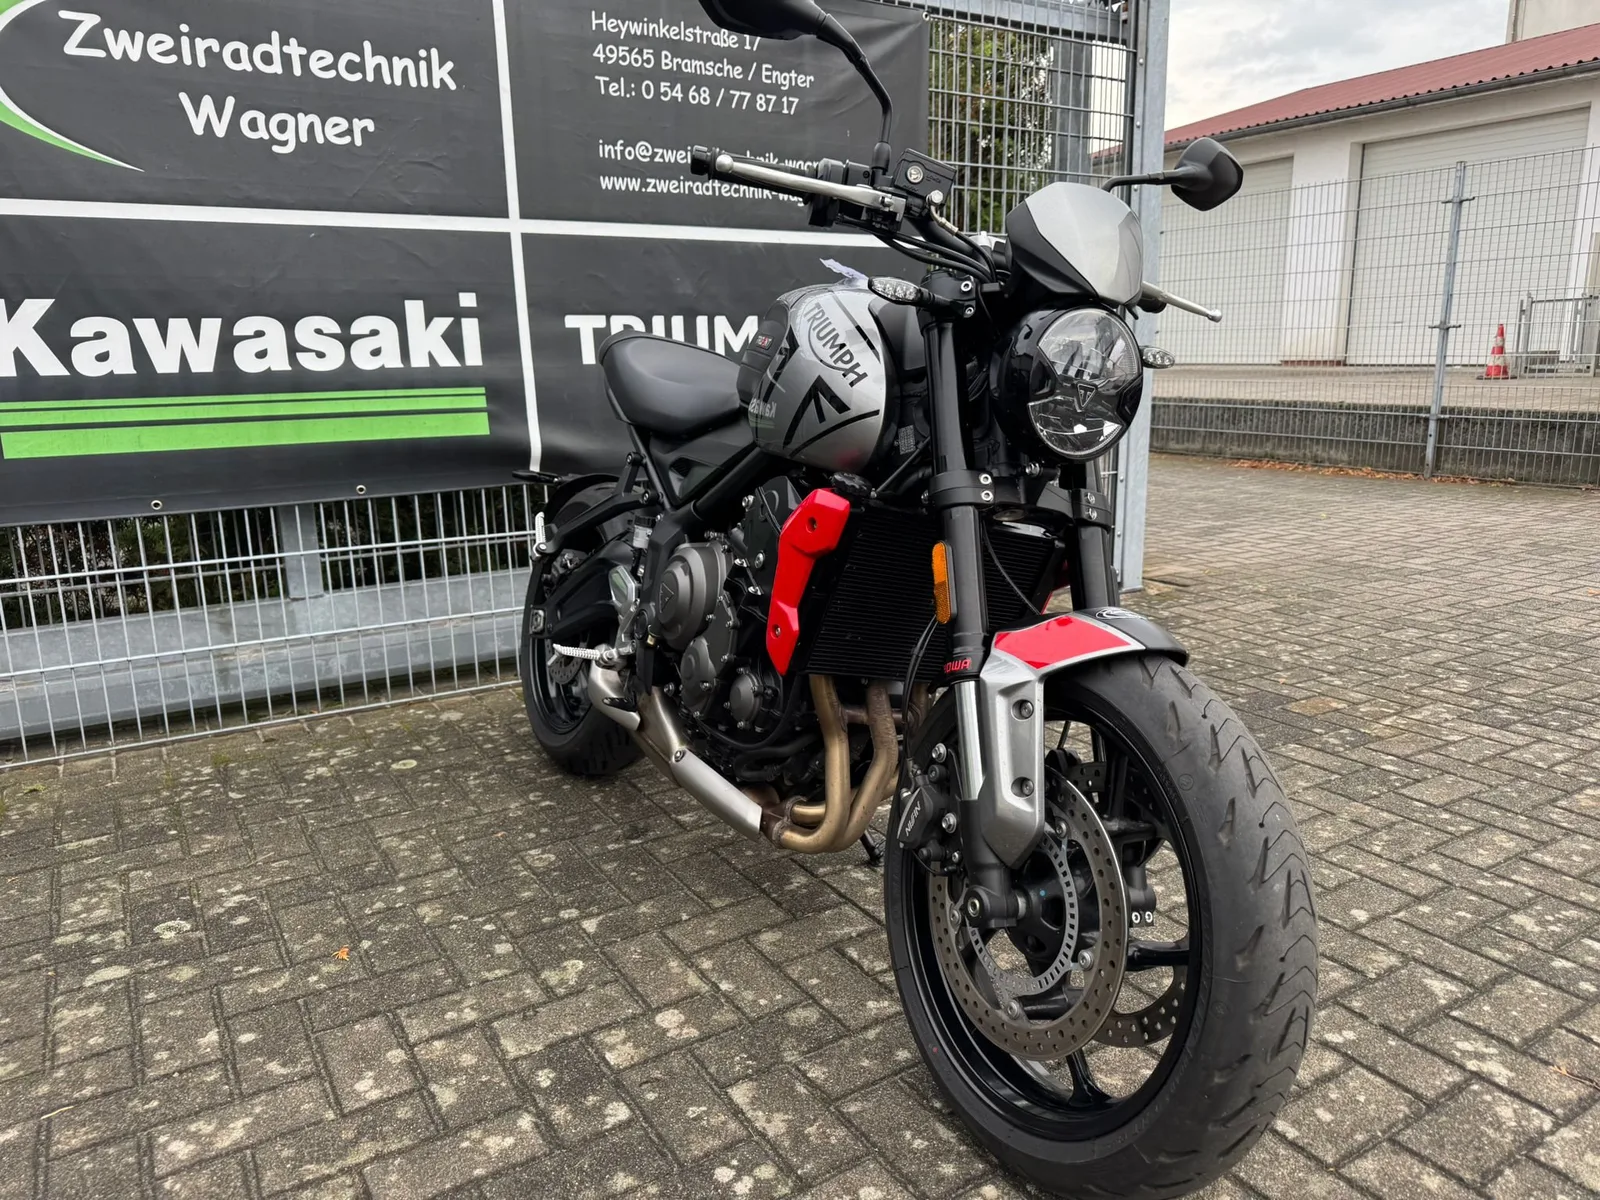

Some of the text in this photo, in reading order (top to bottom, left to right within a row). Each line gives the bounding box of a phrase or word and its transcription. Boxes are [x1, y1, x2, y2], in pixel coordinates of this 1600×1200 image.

[57, 9, 458, 91] Zweiradtechnik
[591, 10, 739, 48] Heywinkelstraße
[592, 43, 815, 90] 49565 Bramsche / Engter
[178, 91, 375, 154] Wagner
[594, 75, 800, 115] Tel.: 0 54 68 / 77 87 17
[0, 291, 484, 378] Kawasaki
[803, 301, 869, 388] TRIUMPH
[944, 657, 972, 673] OWA
